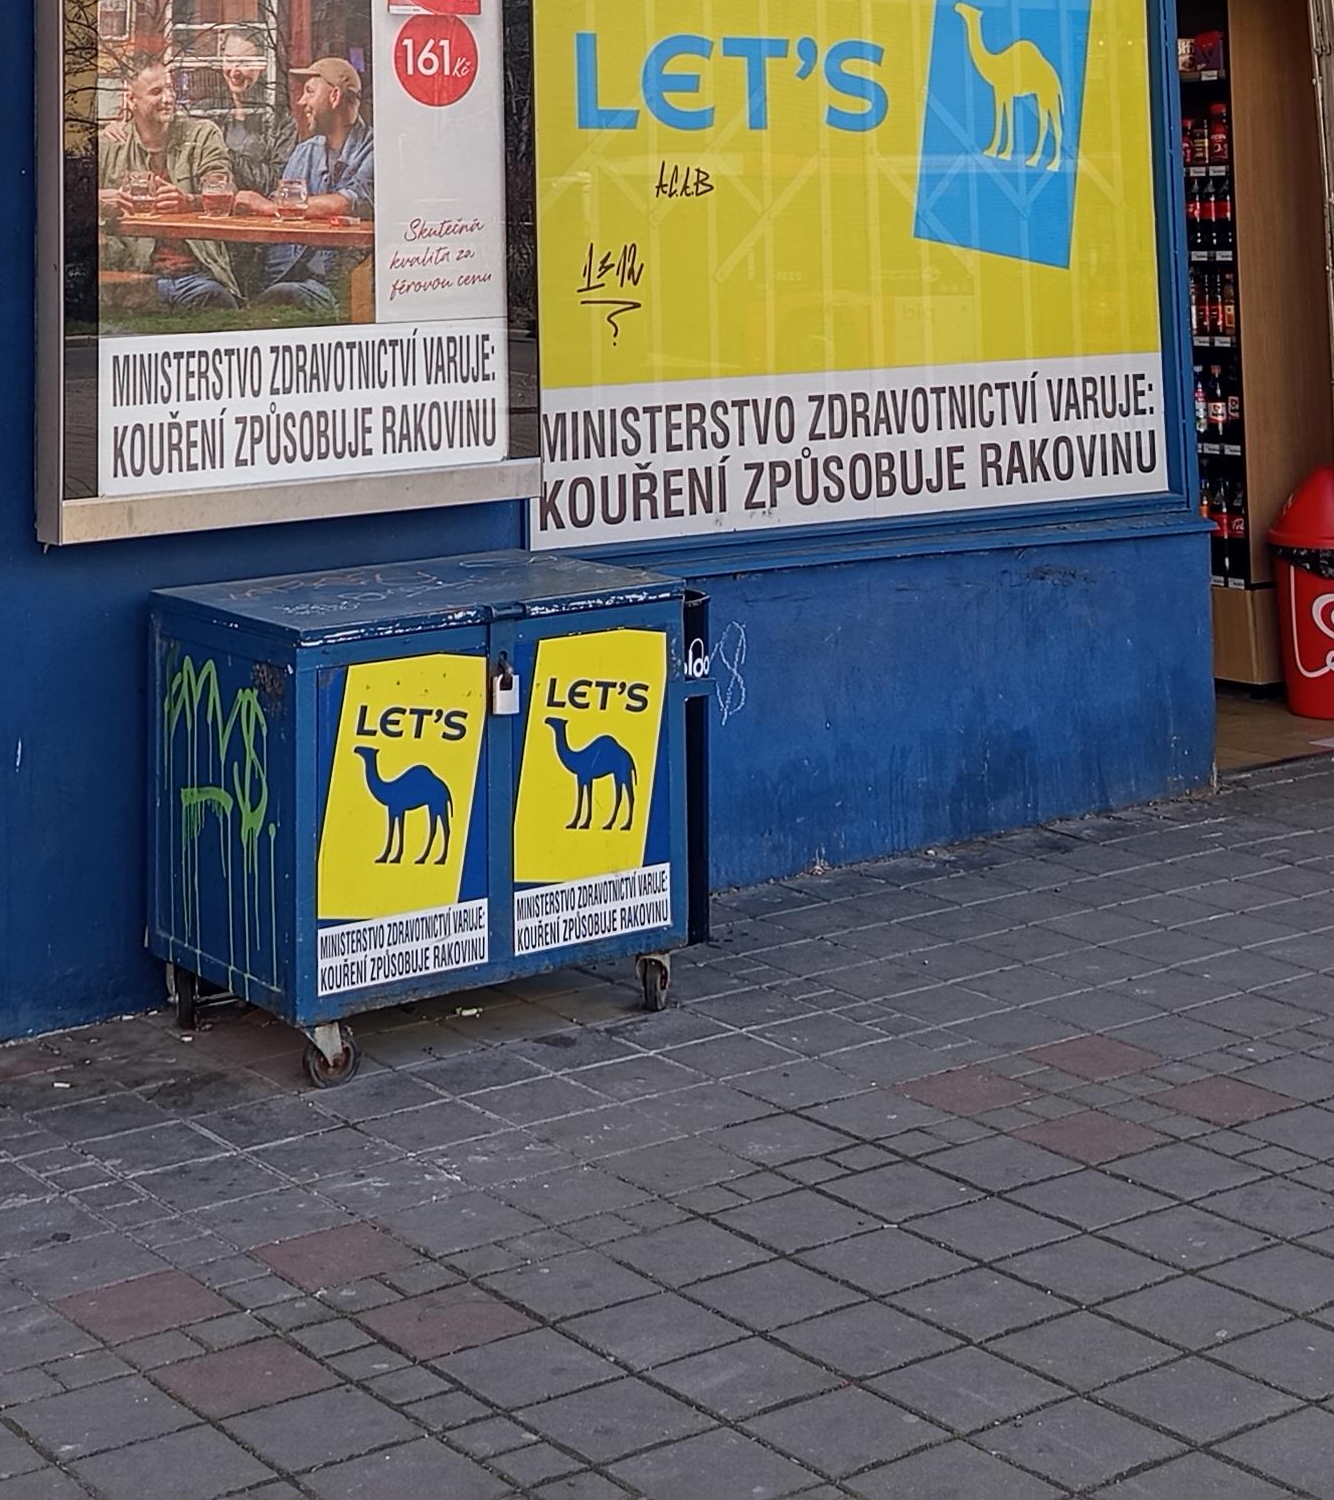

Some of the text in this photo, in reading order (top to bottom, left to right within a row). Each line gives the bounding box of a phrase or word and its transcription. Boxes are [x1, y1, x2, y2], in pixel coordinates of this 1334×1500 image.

[402, 38, 472, 78] 161 Kč
[403, 218, 485, 242] Skutečná
[389, 246, 475, 270] kvalita za
[389, 272, 492, 301] férovou cenu
[112, 328, 496, 408] MINISTERSTVO ZDRAVOTNICTVÍ VARUJE:
[112, 397, 497, 479] KOUŘENÍ ZPŮSOBUJE RAKOVINU
[541, 371, 1155, 463] MINISTERSTVO ZDRAVOTNICTVÍ VARUJE:
[539, 429, 1157, 532] KOUŘENÍ ZPŮSOBUJE RAKOVINU
[515, 870, 669, 923] MINISTERSTVO ZDRAVOTNICTVÍ VARUJE:
[319, 906, 487, 959] MINISTERSTVO ZDRAVOTNICTVÍ VARUJE:
[516, 900, 669, 952] KOUŘENÍ ZPŮSOBUJE RAKOVINU
[319, 935, 487, 993] KOUŘENÍ ZPŮSOBUJE RAKOVINU
